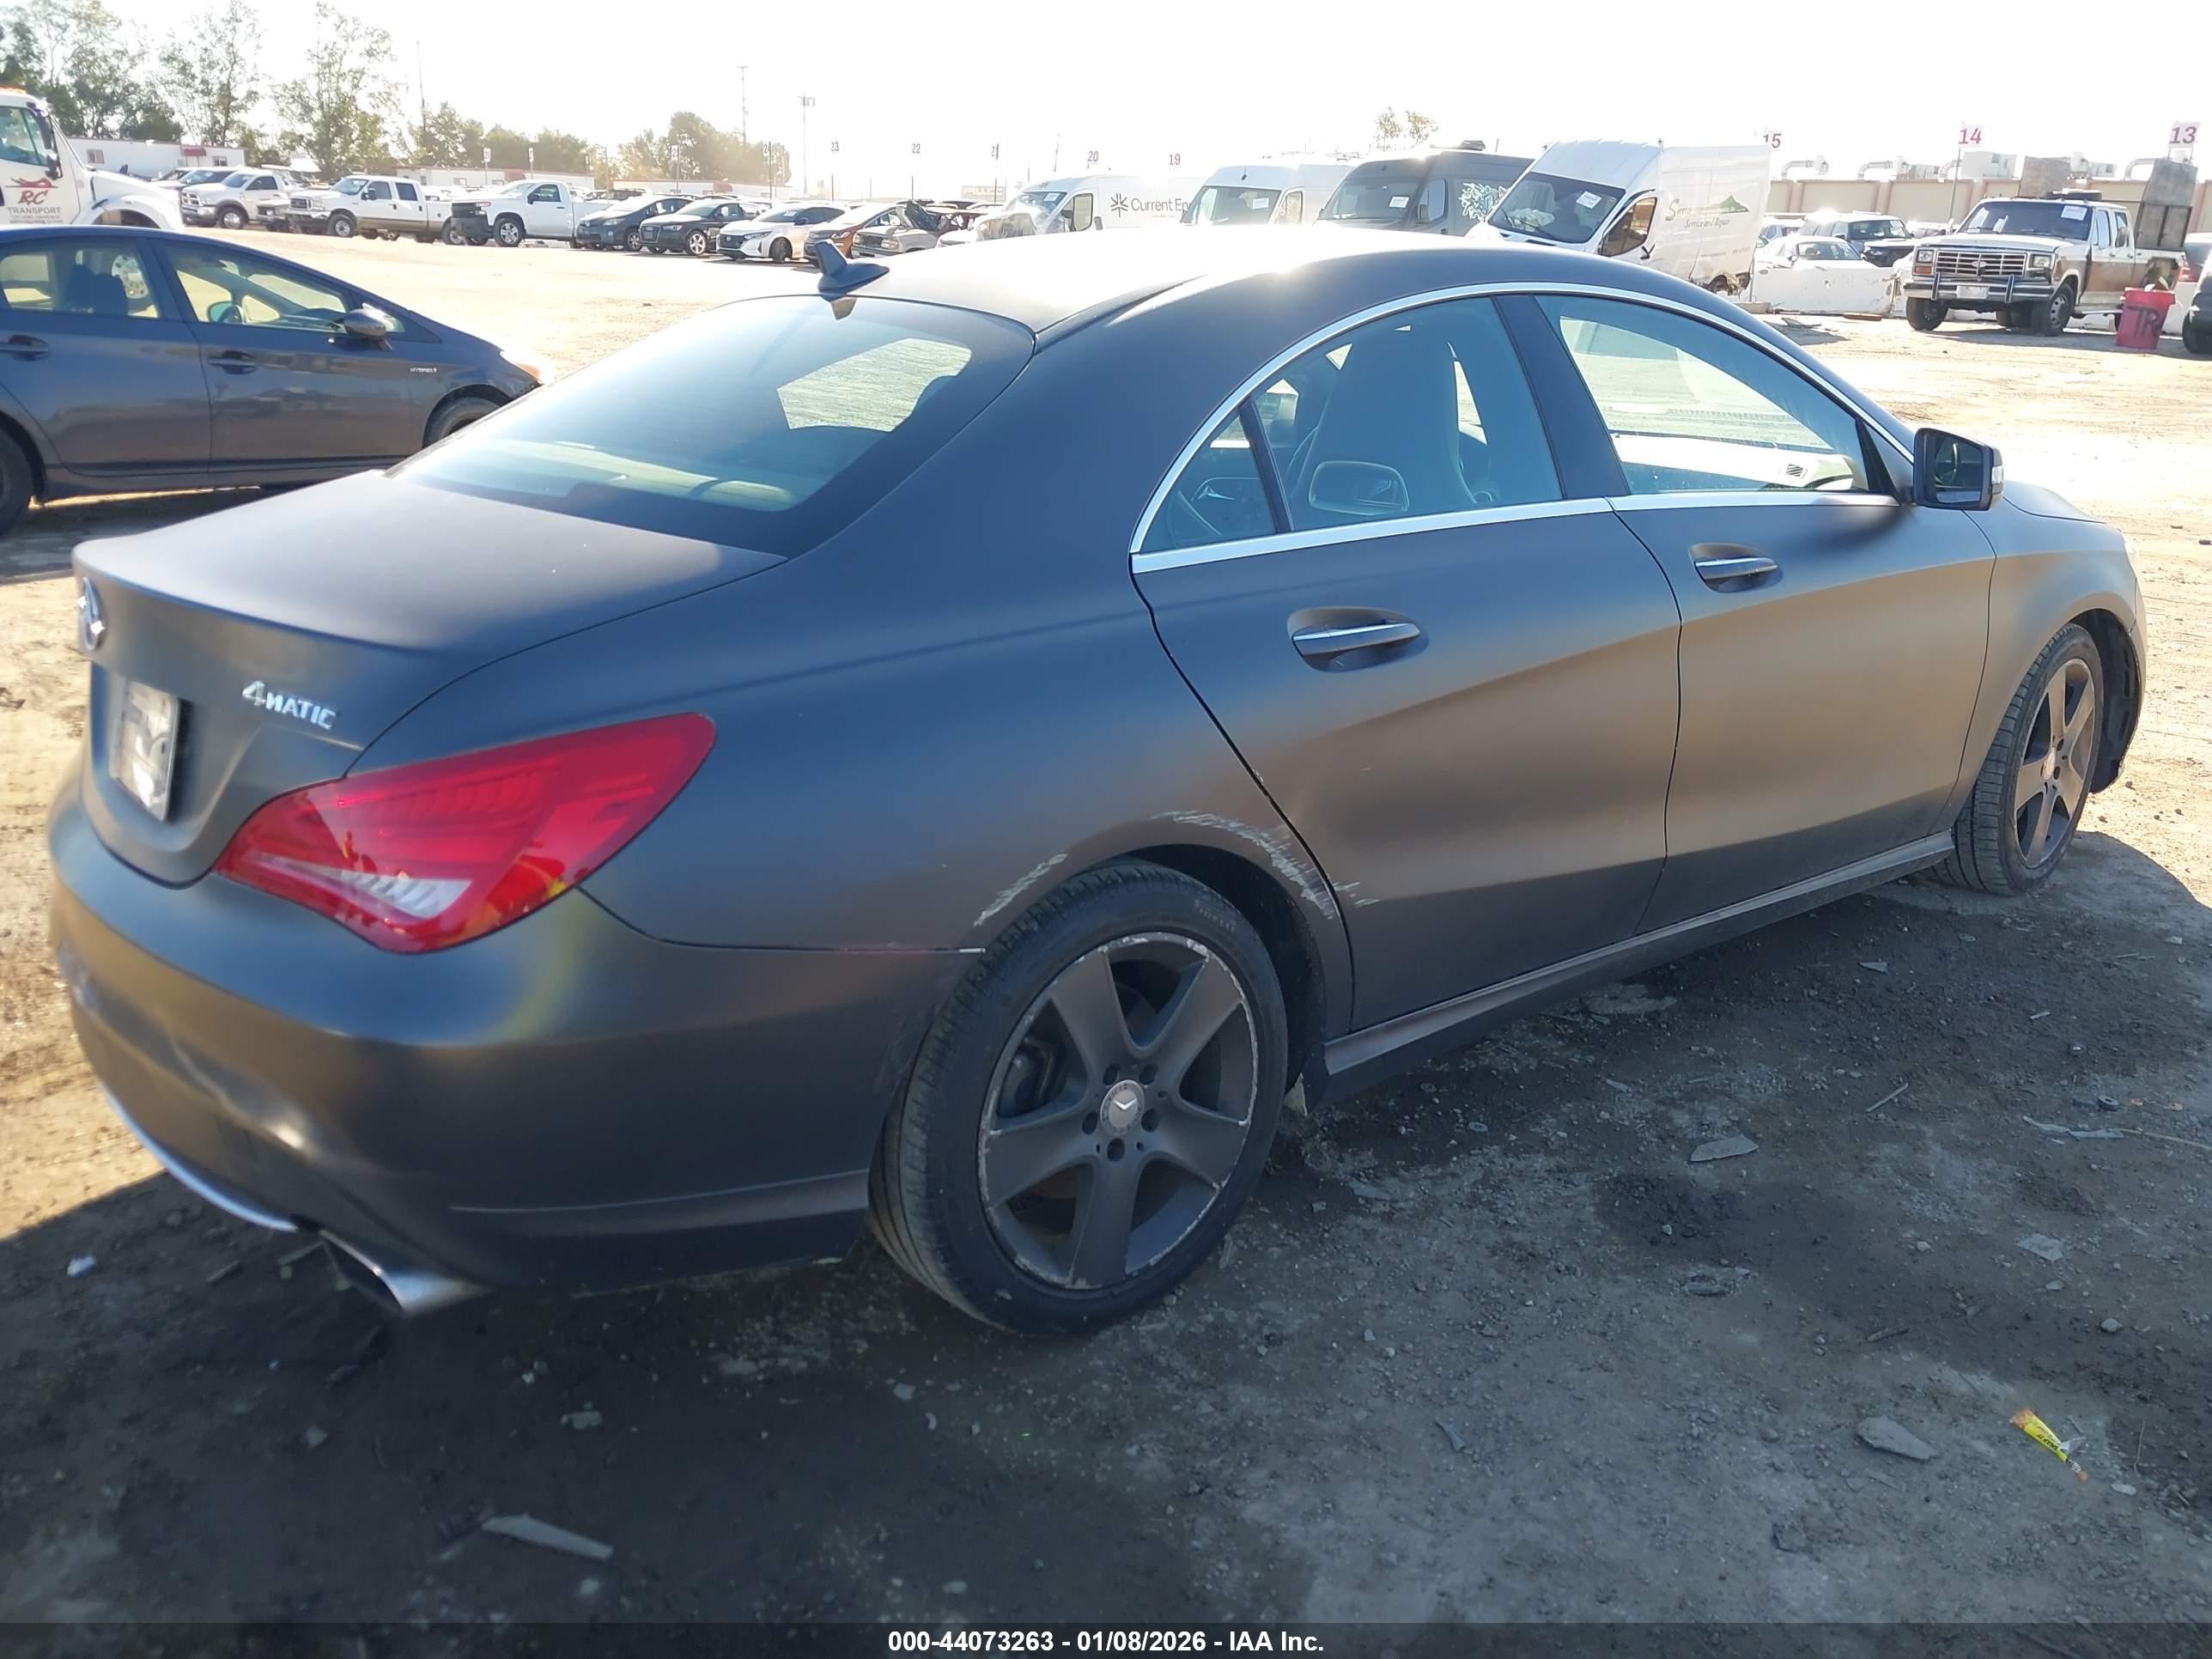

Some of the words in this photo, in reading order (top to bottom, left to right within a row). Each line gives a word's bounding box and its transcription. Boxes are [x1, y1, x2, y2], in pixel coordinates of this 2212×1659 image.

[1763, 133, 1782, 149] 15
[1958, 128, 1982, 144] 14
[2169, 126, 2197, 144] 13
[830, 142, 839, 152] 23
[912, 143, 921, 153] 22
[1086, 150, 1099, 162] 20
[1169, 153, 1181, 166] 19
[1131, 198, 1173, 212] Current
[241, 680, 337, 731] 4MATIC
